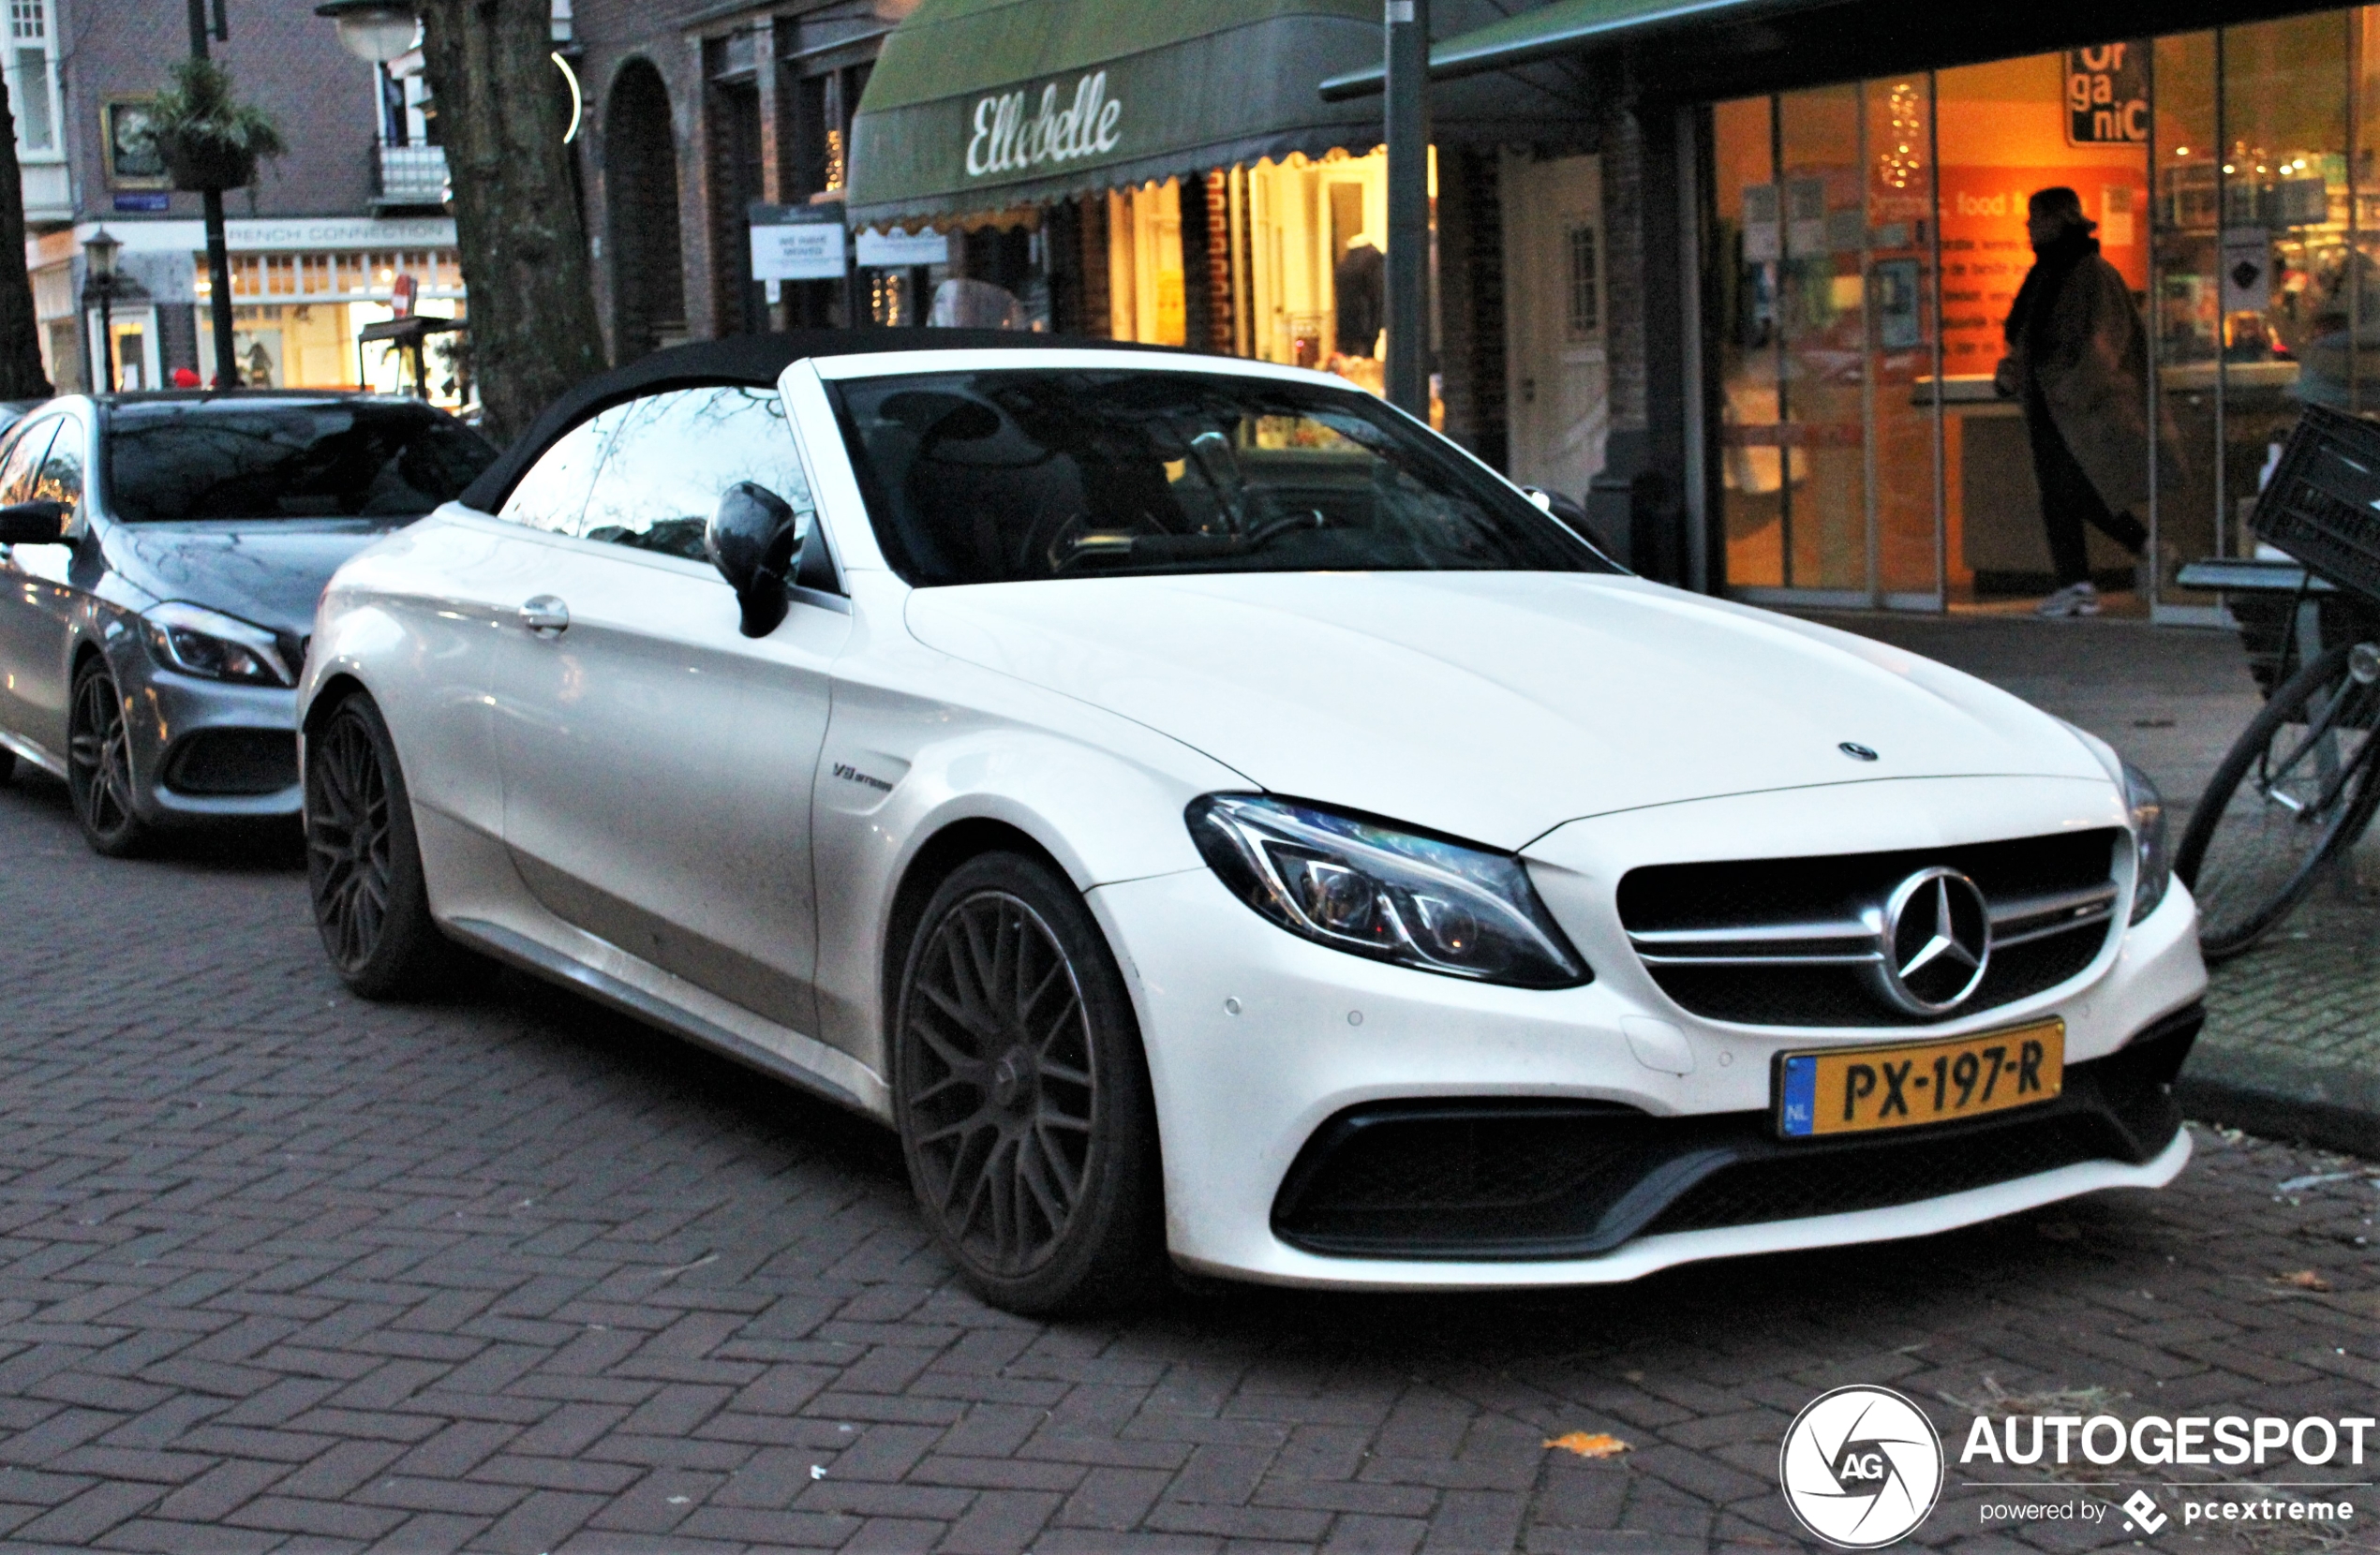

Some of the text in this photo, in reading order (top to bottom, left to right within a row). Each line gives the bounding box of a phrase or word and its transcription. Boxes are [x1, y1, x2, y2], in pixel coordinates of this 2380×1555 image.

[2066, 73, 2112, 112] ga
[966, 69, 1122, 176] Ellebelle
[228, 227, 302, 243] RENCH
[1842, 1039, 2045, 1122] PX-197-R
[1786, 1103, 1809, 1121] NL
